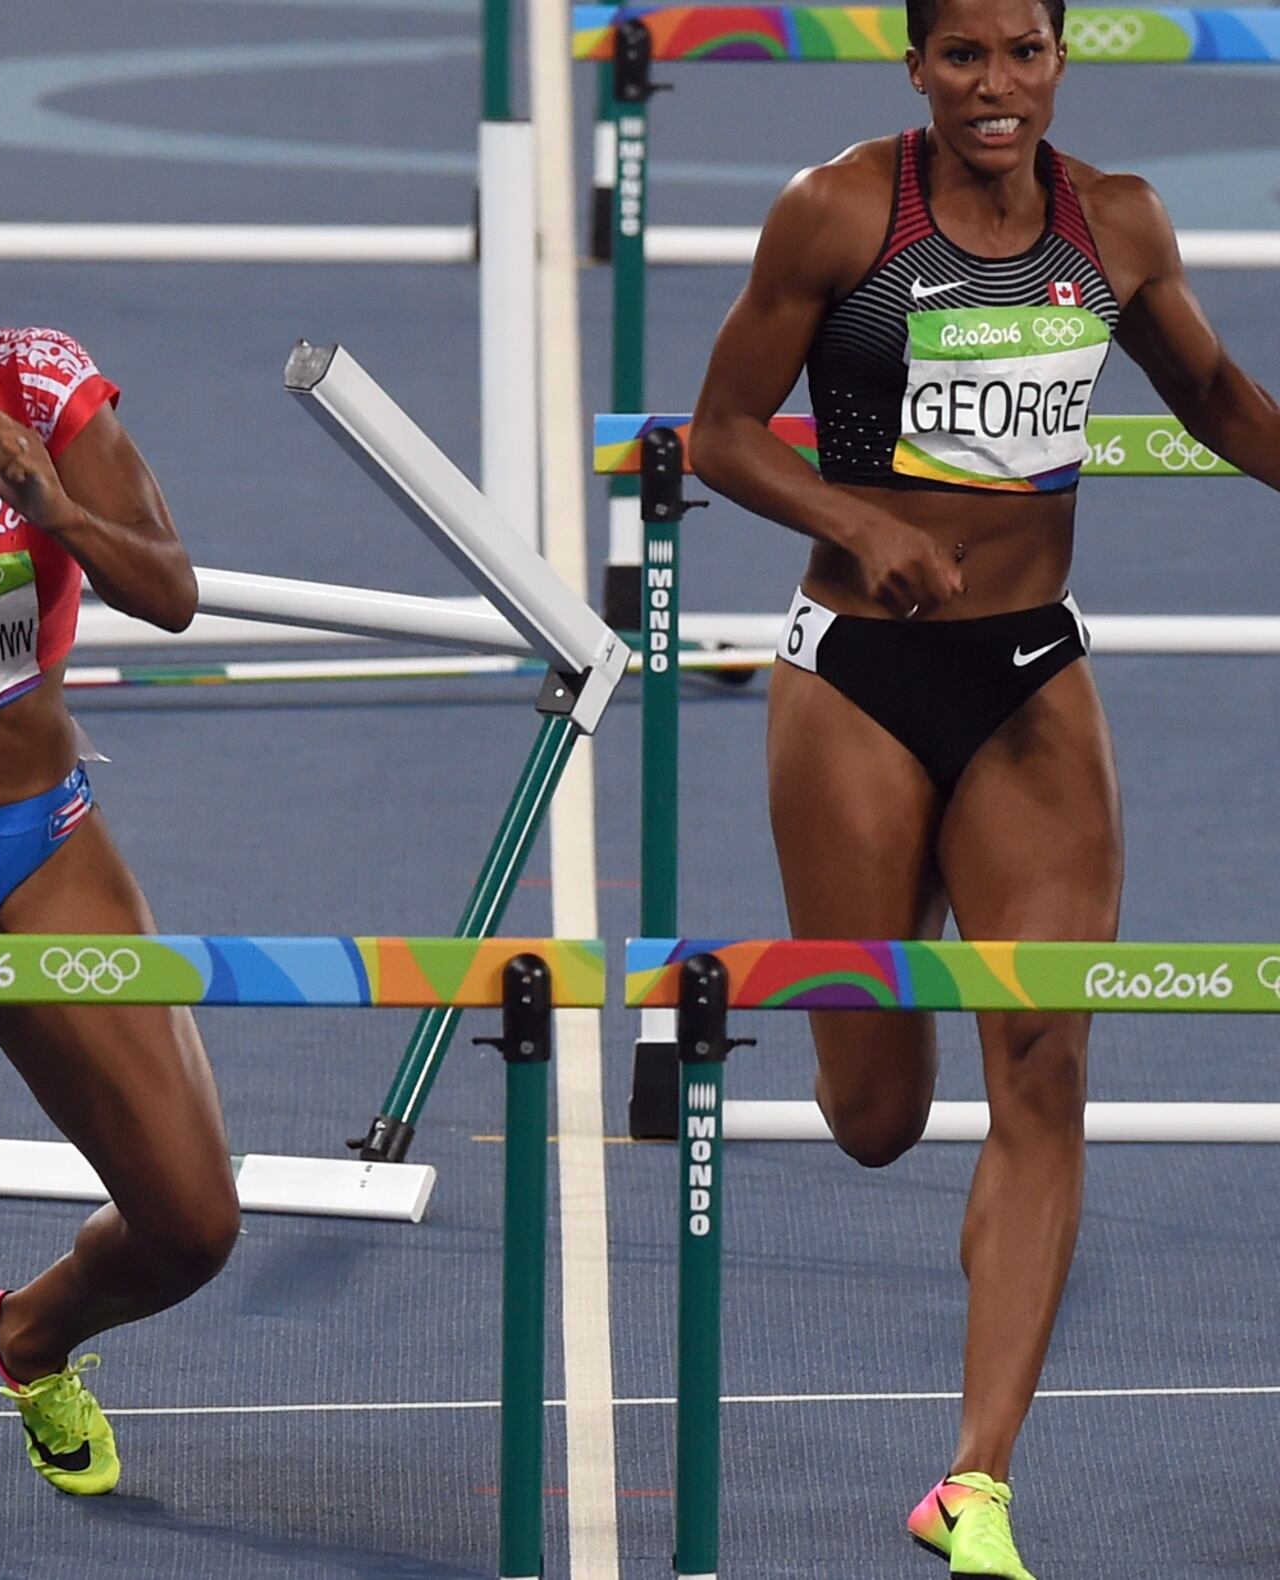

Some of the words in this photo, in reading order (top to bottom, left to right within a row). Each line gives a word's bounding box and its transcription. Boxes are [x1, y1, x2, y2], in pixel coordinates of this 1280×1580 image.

[940, 321, 1021, 346] Rio2016
[910, 379, 1092, 438] GEORGE
[648, 568, 673, 673] MONDO
[787, 605, 812, 656] 6
[1084, 962, 1233, 999] Rio2016
[687, 1115, 716, 1237] MONDO
